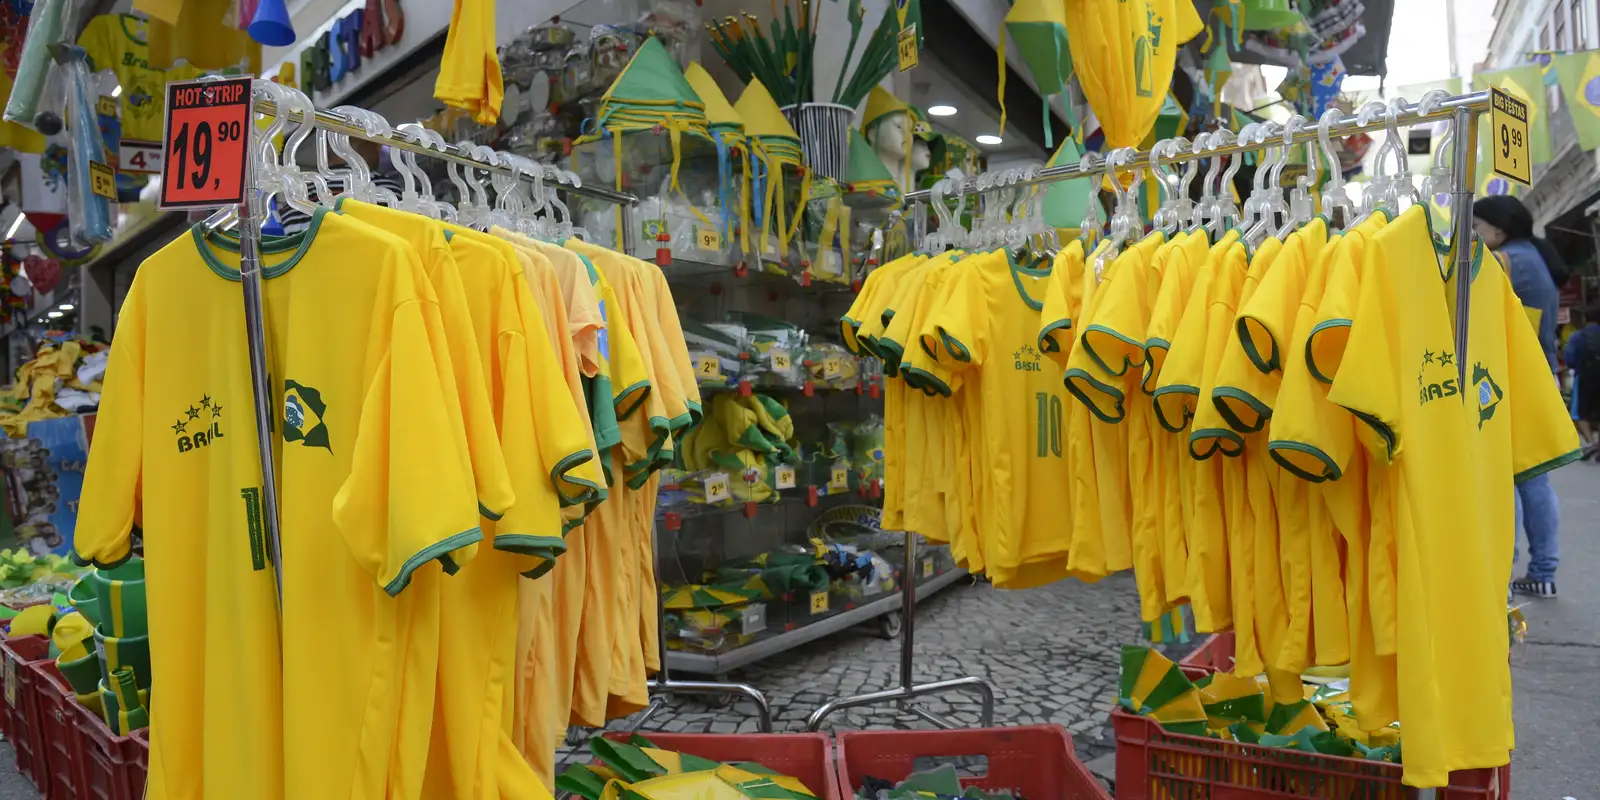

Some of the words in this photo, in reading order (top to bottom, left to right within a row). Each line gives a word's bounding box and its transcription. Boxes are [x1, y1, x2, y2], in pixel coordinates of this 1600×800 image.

[121, 51, 149, 70] Bra
[175, 87, 203, 107] HOT
[204, 84, 244, 105] STRIP
[1494, 93, 1505, 110] BIG
[1504, 99, 1526, 121] FESTAS
[1036, 391, 1063, 458] 10
